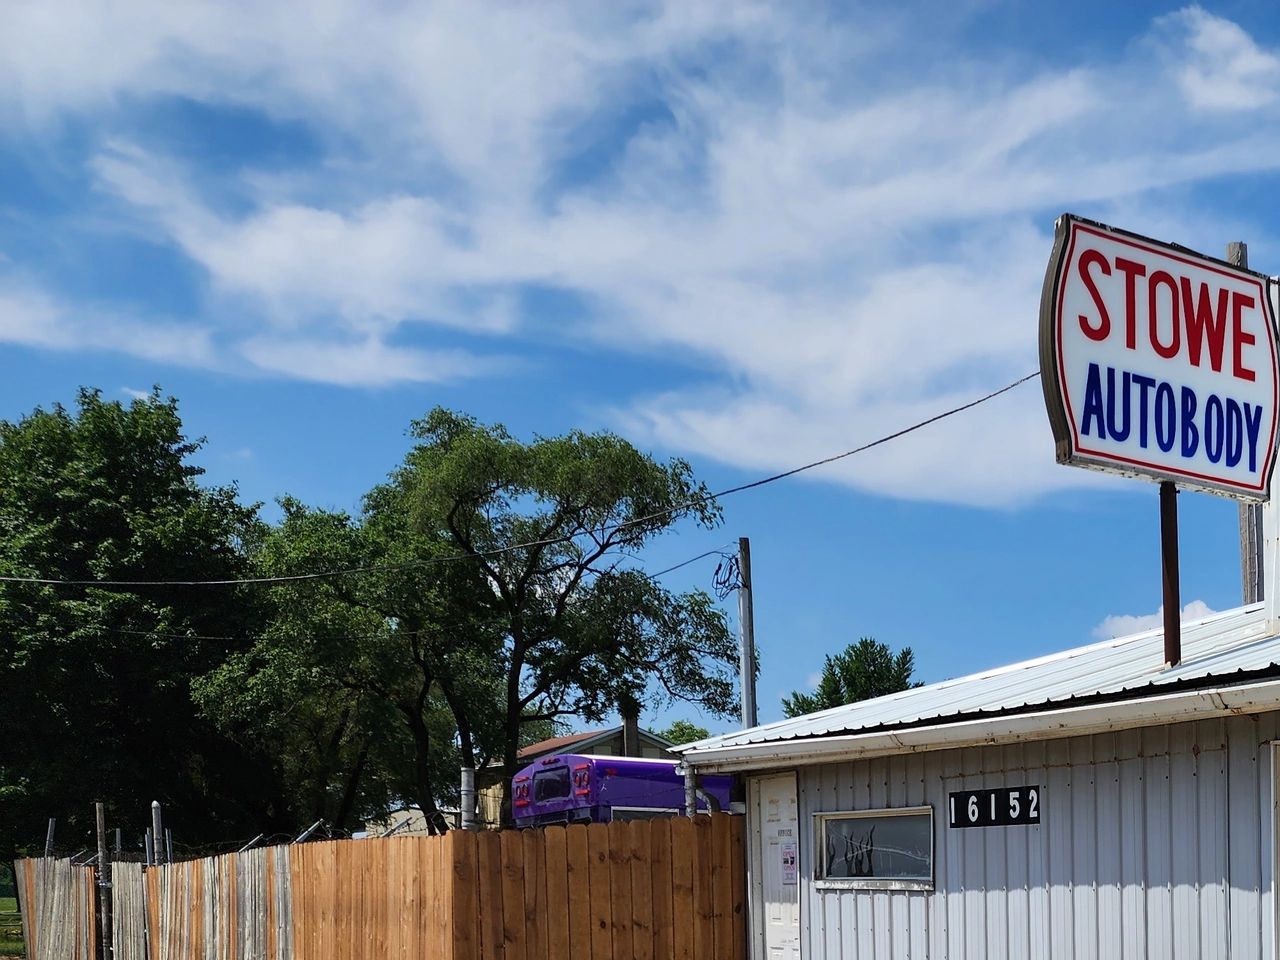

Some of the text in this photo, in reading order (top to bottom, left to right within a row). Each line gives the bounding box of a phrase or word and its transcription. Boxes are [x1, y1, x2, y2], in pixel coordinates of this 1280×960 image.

[1078, 249, 1256, 383] STOWE
[1081, 362, 1263, 474] AUTOBODY
[950, 789, 1038, 824] 16152
